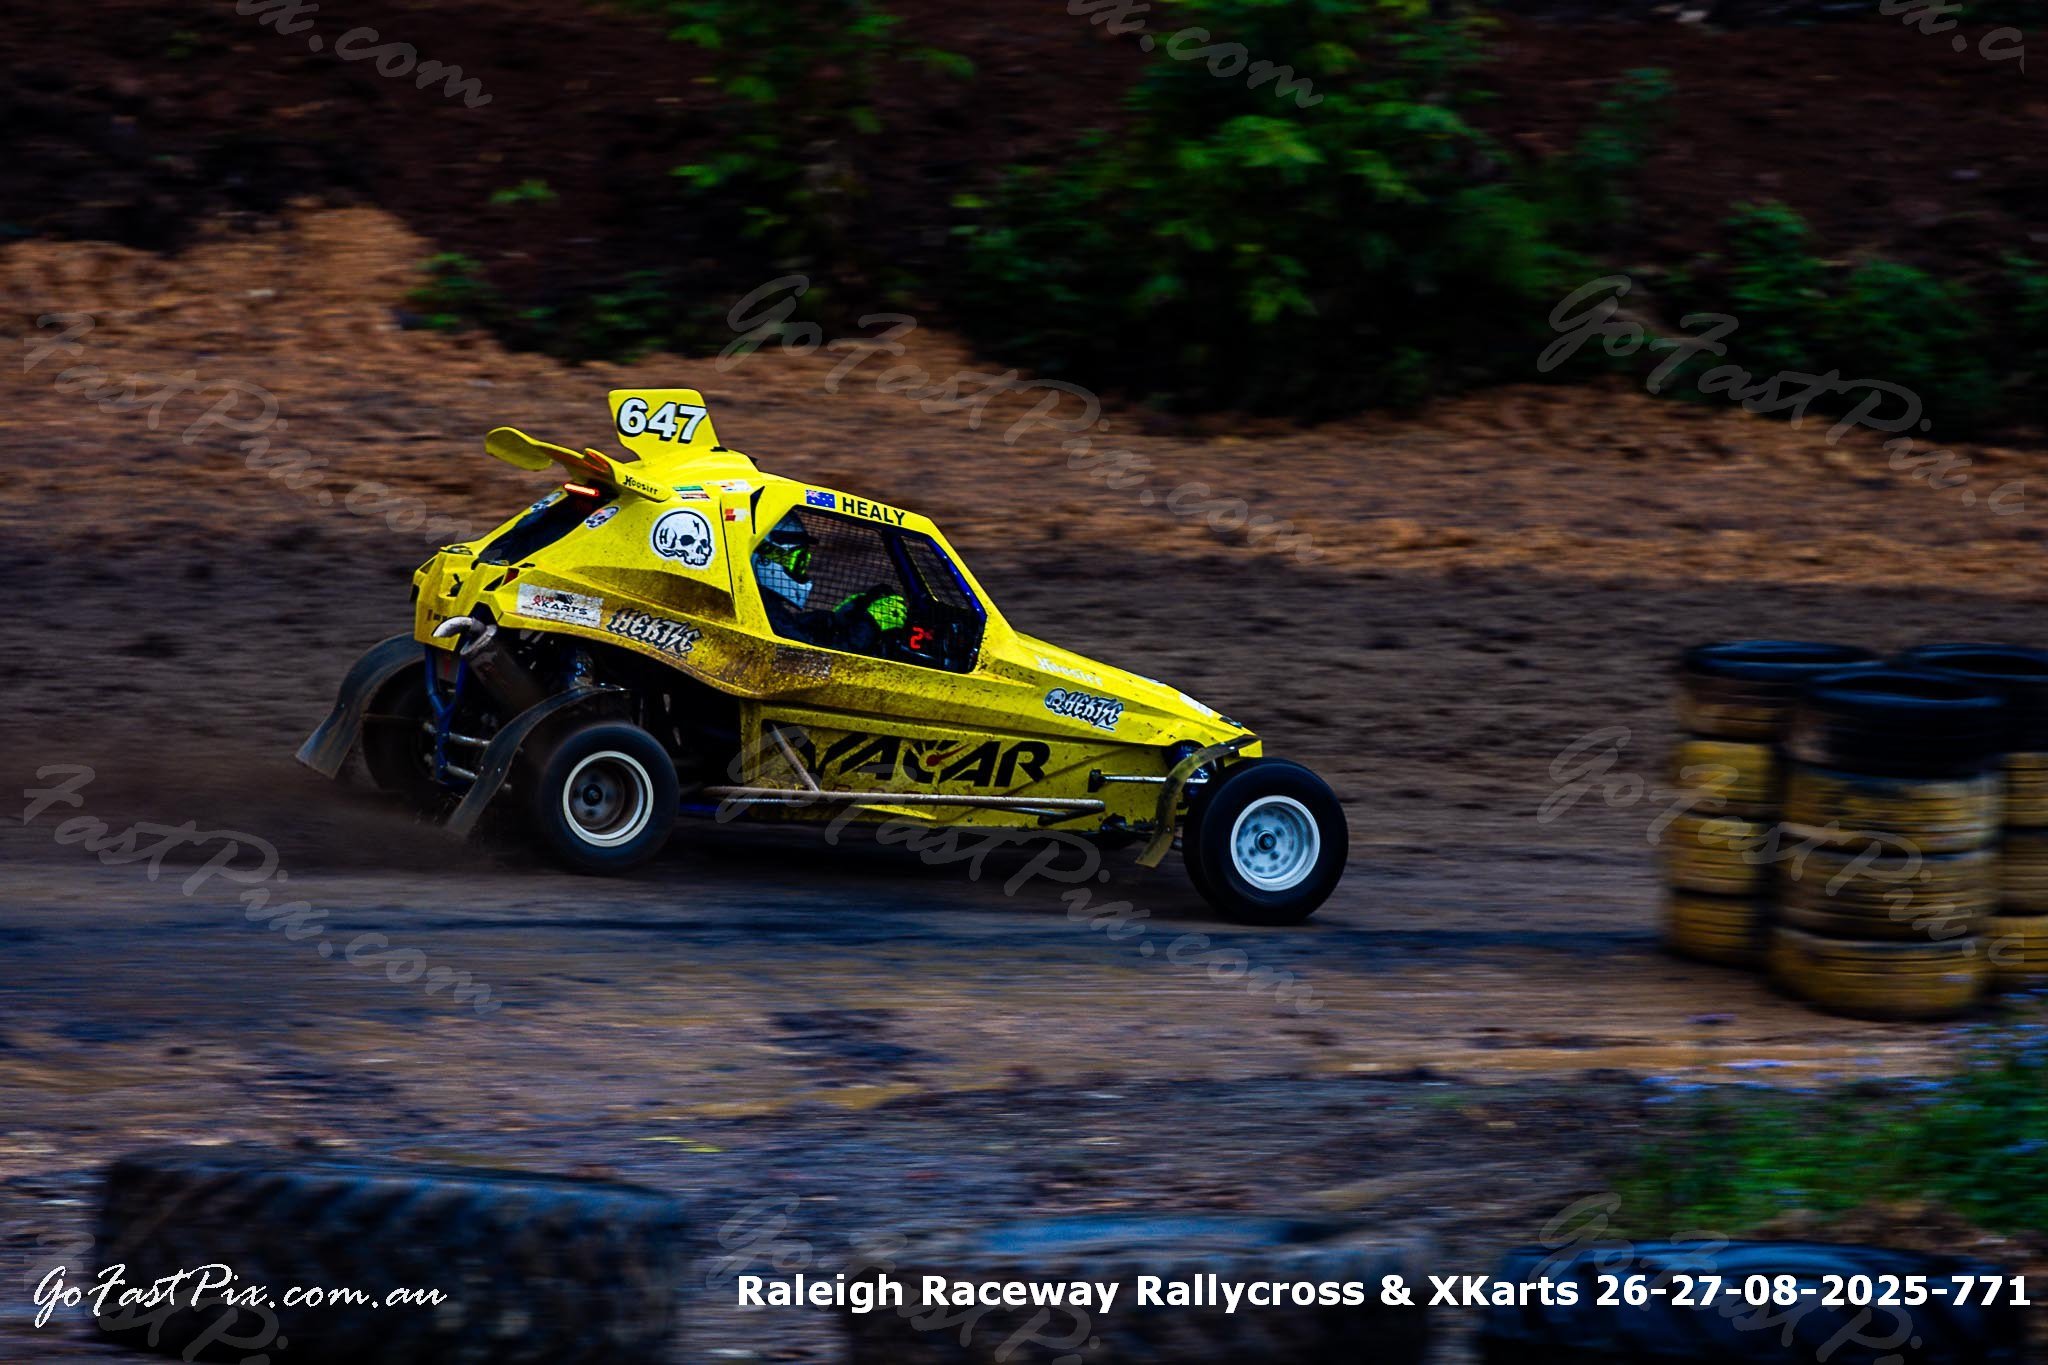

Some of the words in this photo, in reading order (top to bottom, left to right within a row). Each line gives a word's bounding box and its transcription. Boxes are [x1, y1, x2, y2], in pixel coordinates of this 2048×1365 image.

[617, 397, 707, 444] 647
[623, 474, 658, 495] Hoosier
[842, 496, 906, 526] HEALY
